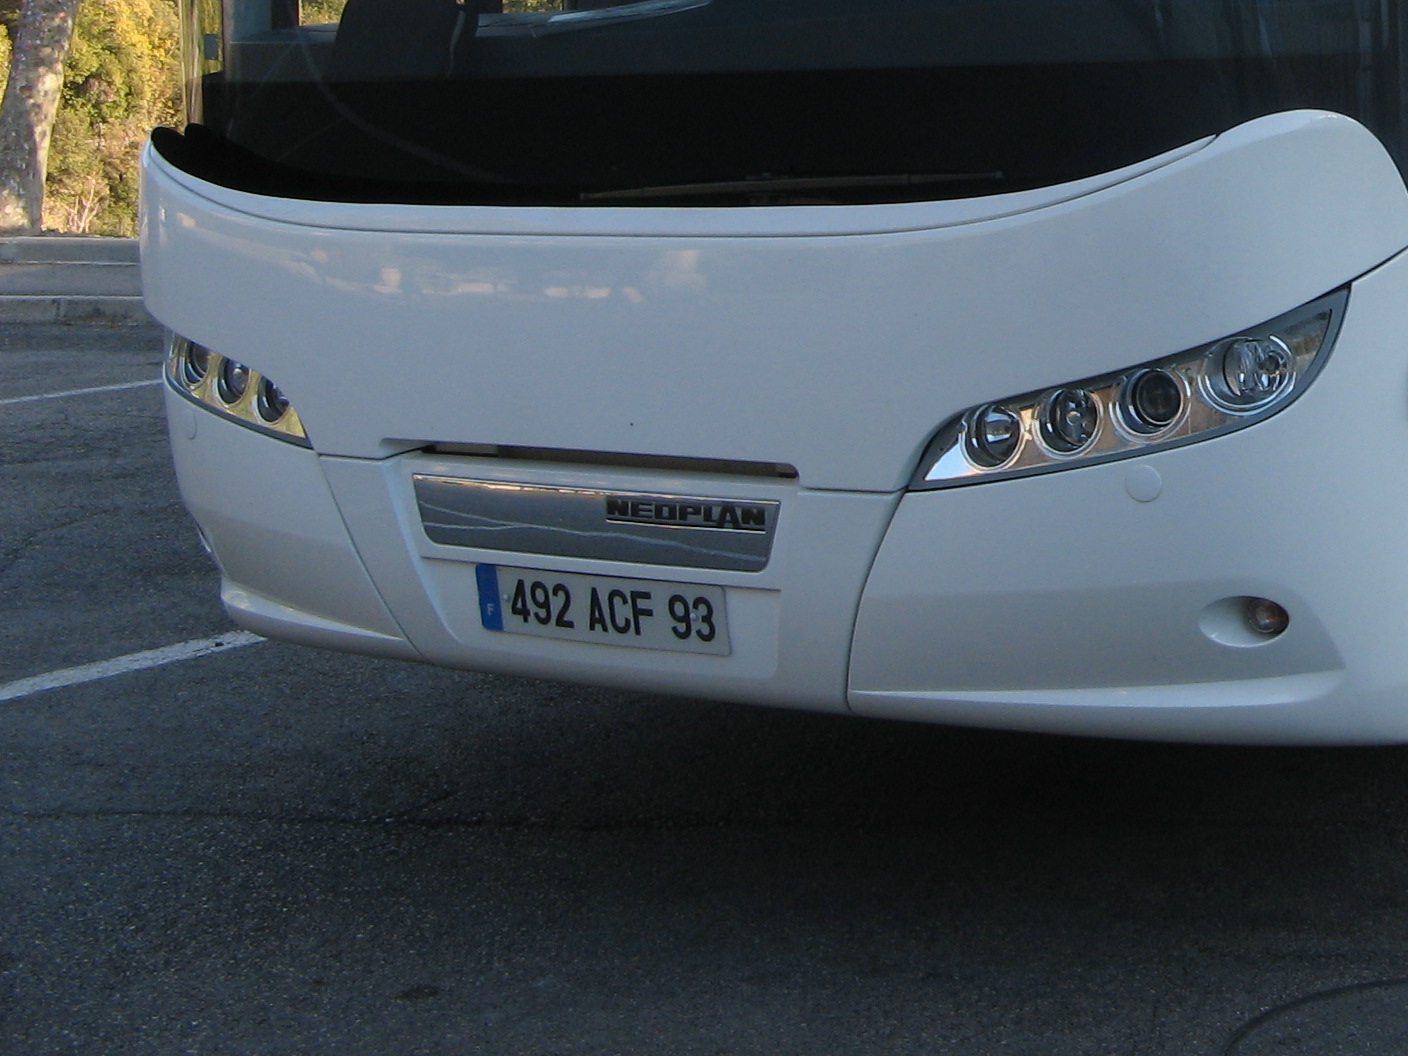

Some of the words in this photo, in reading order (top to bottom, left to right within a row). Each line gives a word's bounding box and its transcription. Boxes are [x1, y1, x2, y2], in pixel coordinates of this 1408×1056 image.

[606, 497, 767, 530] NEOPLAN
[487, 602, 494, 616] F
[511, 578, 575, 629] 492
[589, 587, 654, 636] ACF
[668, 594, 716, 642] 93
